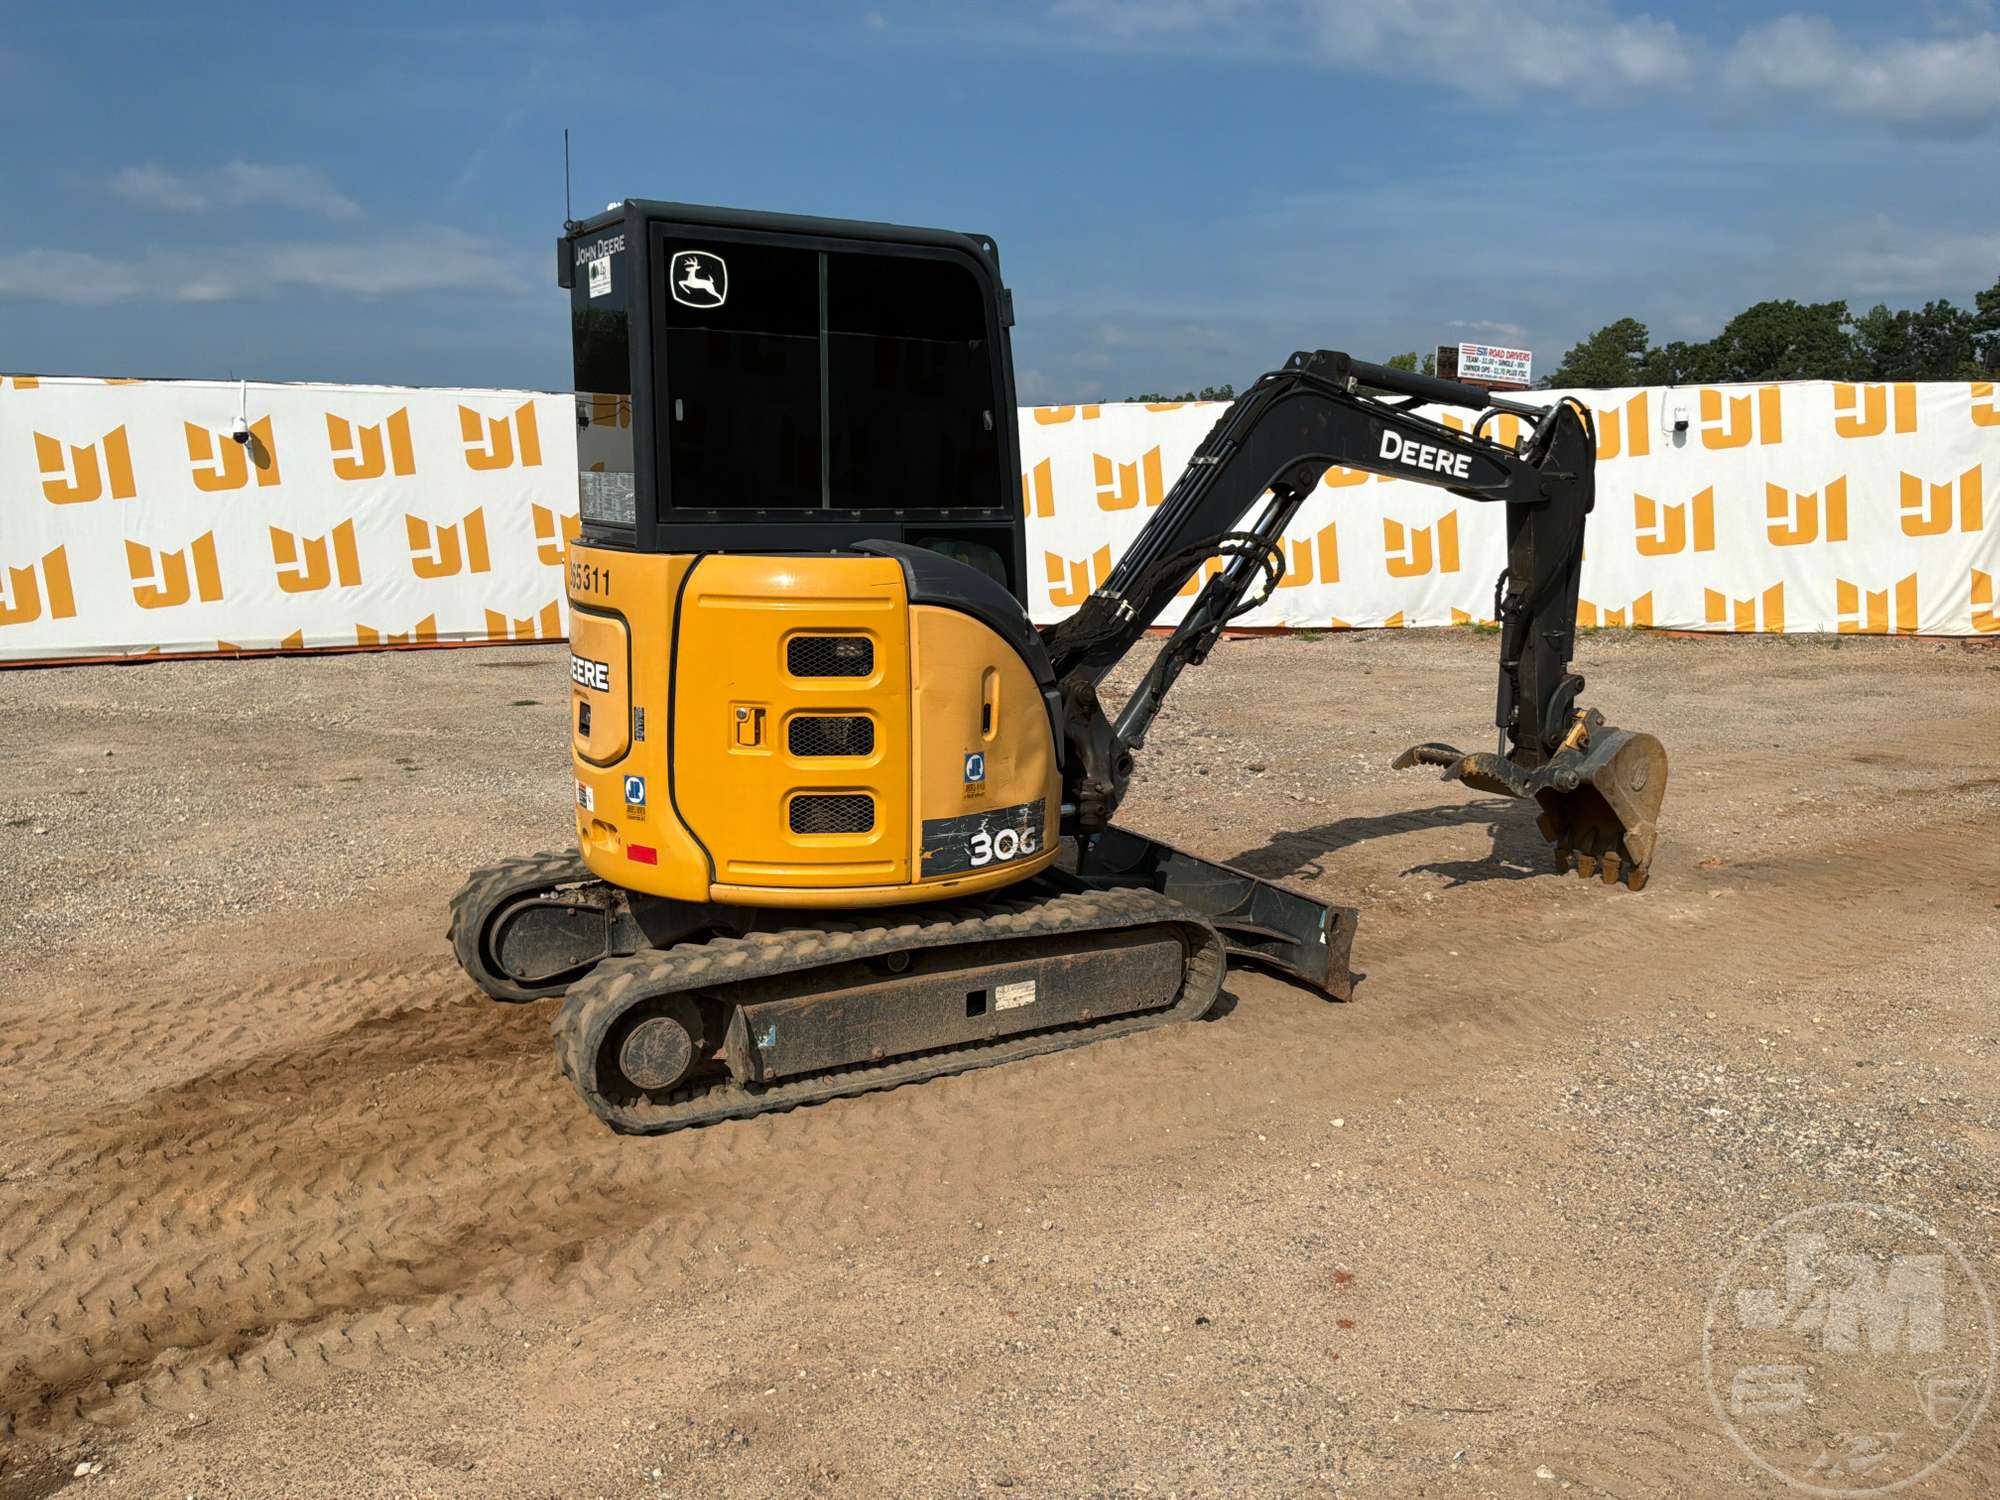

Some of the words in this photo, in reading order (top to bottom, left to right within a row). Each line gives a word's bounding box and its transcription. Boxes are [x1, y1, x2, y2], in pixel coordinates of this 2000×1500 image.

[576, 245, 597, 266] JOHN
[597, 234, 625, 258] DEERE
[1488, 348, 1505, 359] ROAD
[1506, 350, 1530, 362] DRIVERS
[1379, 429, 1472, 479] DEERE
[570, 656, 609, 690] EERE
